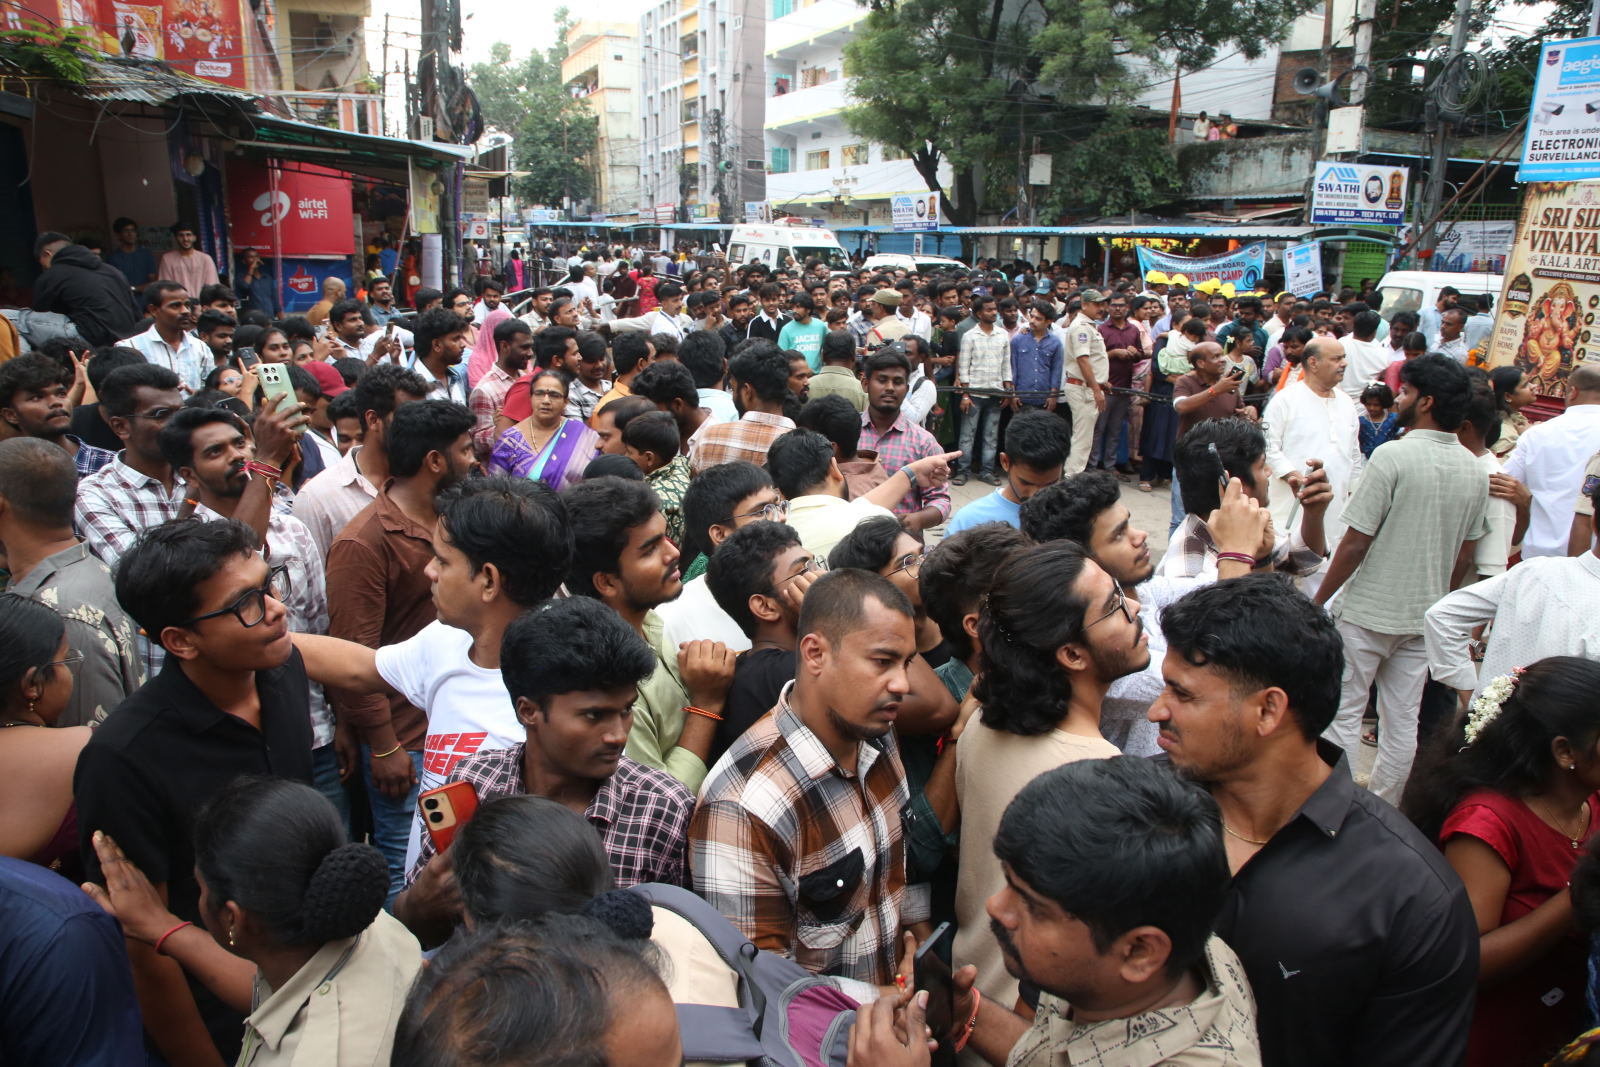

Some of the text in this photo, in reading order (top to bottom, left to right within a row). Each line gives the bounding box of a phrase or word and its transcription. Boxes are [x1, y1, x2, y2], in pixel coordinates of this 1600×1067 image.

[1317, 183, 1360, 194] SWATHI
[298, 198, 328, 209] airtel
[299, 209, 328, 220] Wi-Fi
[1540, 207, 1572, 228] SRI
[1530, 229, 1600, 256] VINAYA
[1222, 261, 1246, 269] BOARD
[1540, 255, 1570, 268] KALA
[1197, 272, 1219, 281] WATER
[1222, 270, 1243, 281] CAMP
[1508, 290, 1531, 301] OPENING
[1498, 341, 1514, 351] HOME
